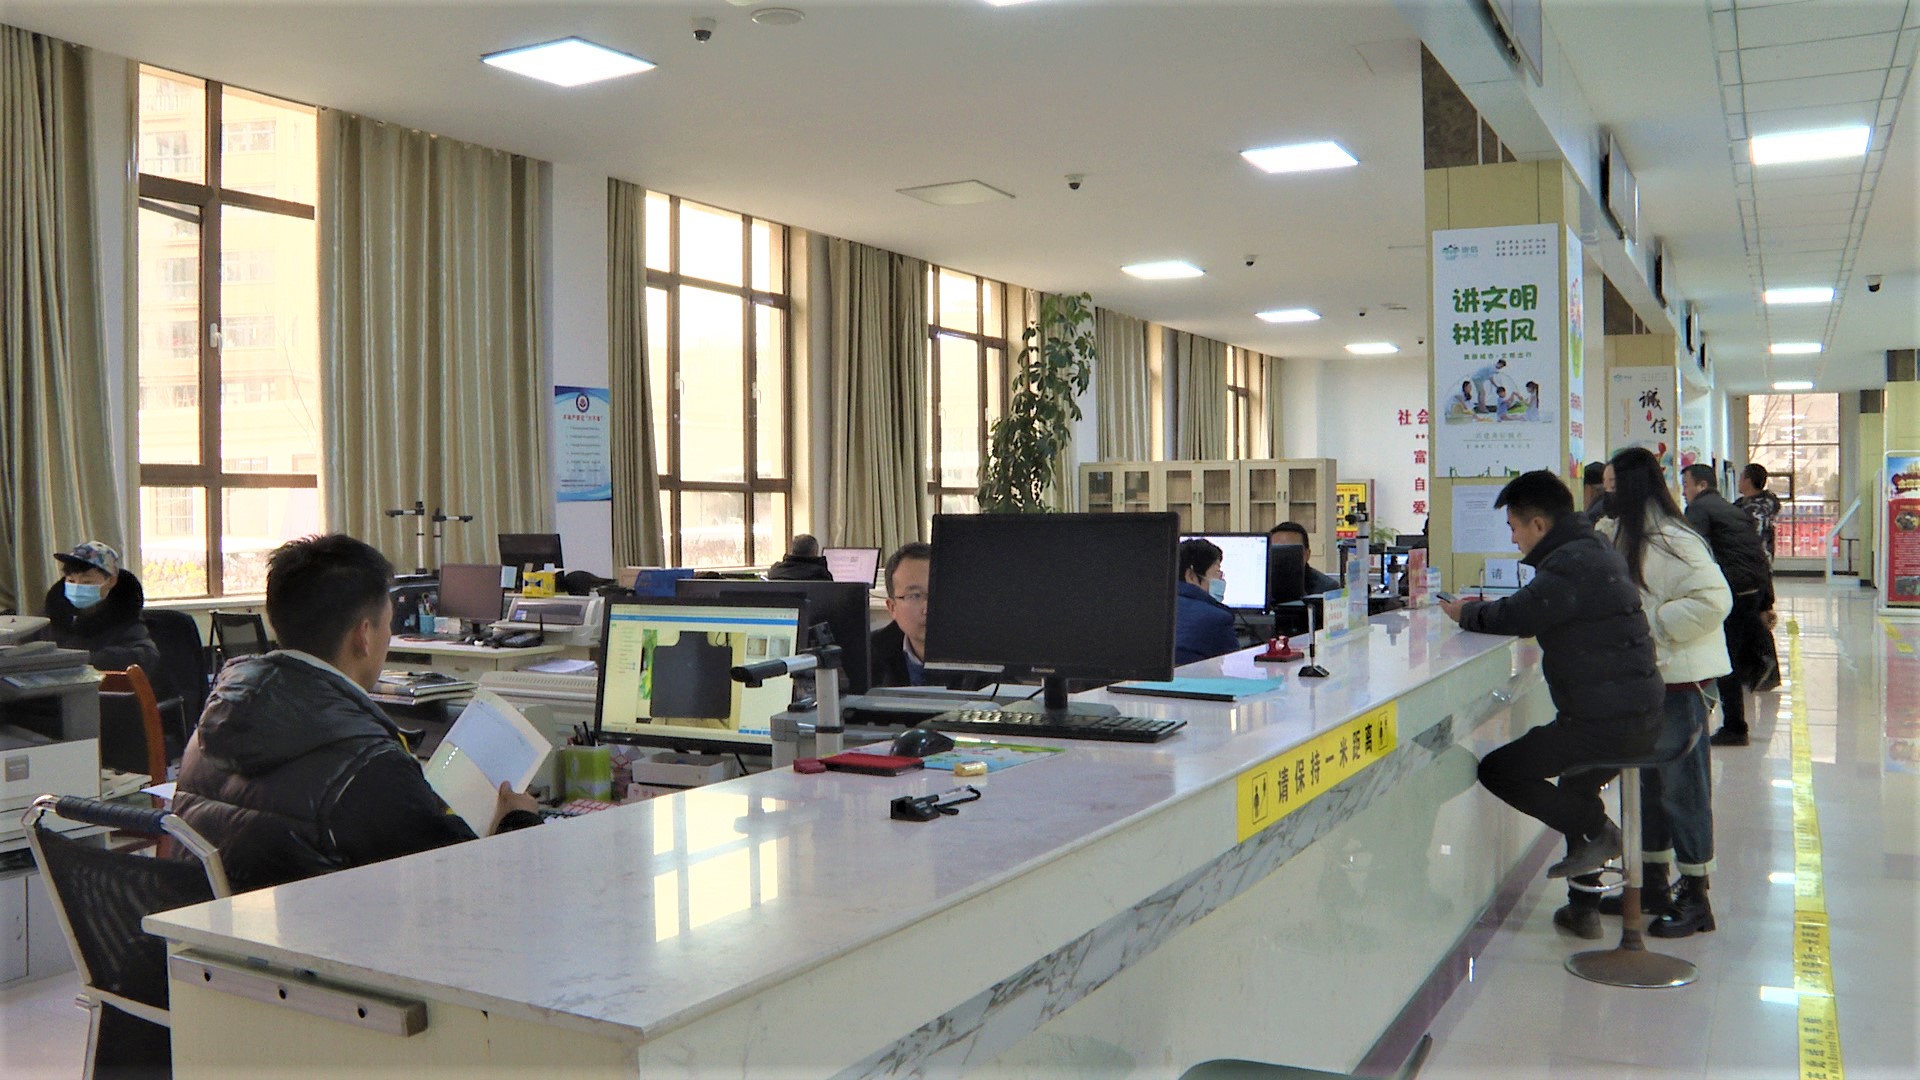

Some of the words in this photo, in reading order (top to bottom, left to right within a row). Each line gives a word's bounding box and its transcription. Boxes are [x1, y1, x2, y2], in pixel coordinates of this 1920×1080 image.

[1452, 284, 1538, 313] 讲文明
[1452, 318, 1538, 346] 树新风
[1397, 408, 1428, 426] 社会
[1413, 449, 1427, 465] 富
[1414, 477, 1426, 492] 自
[1412, 500, 1427, 515] 爱
[1277, 722, 1373, 804] 请保持一米距离
